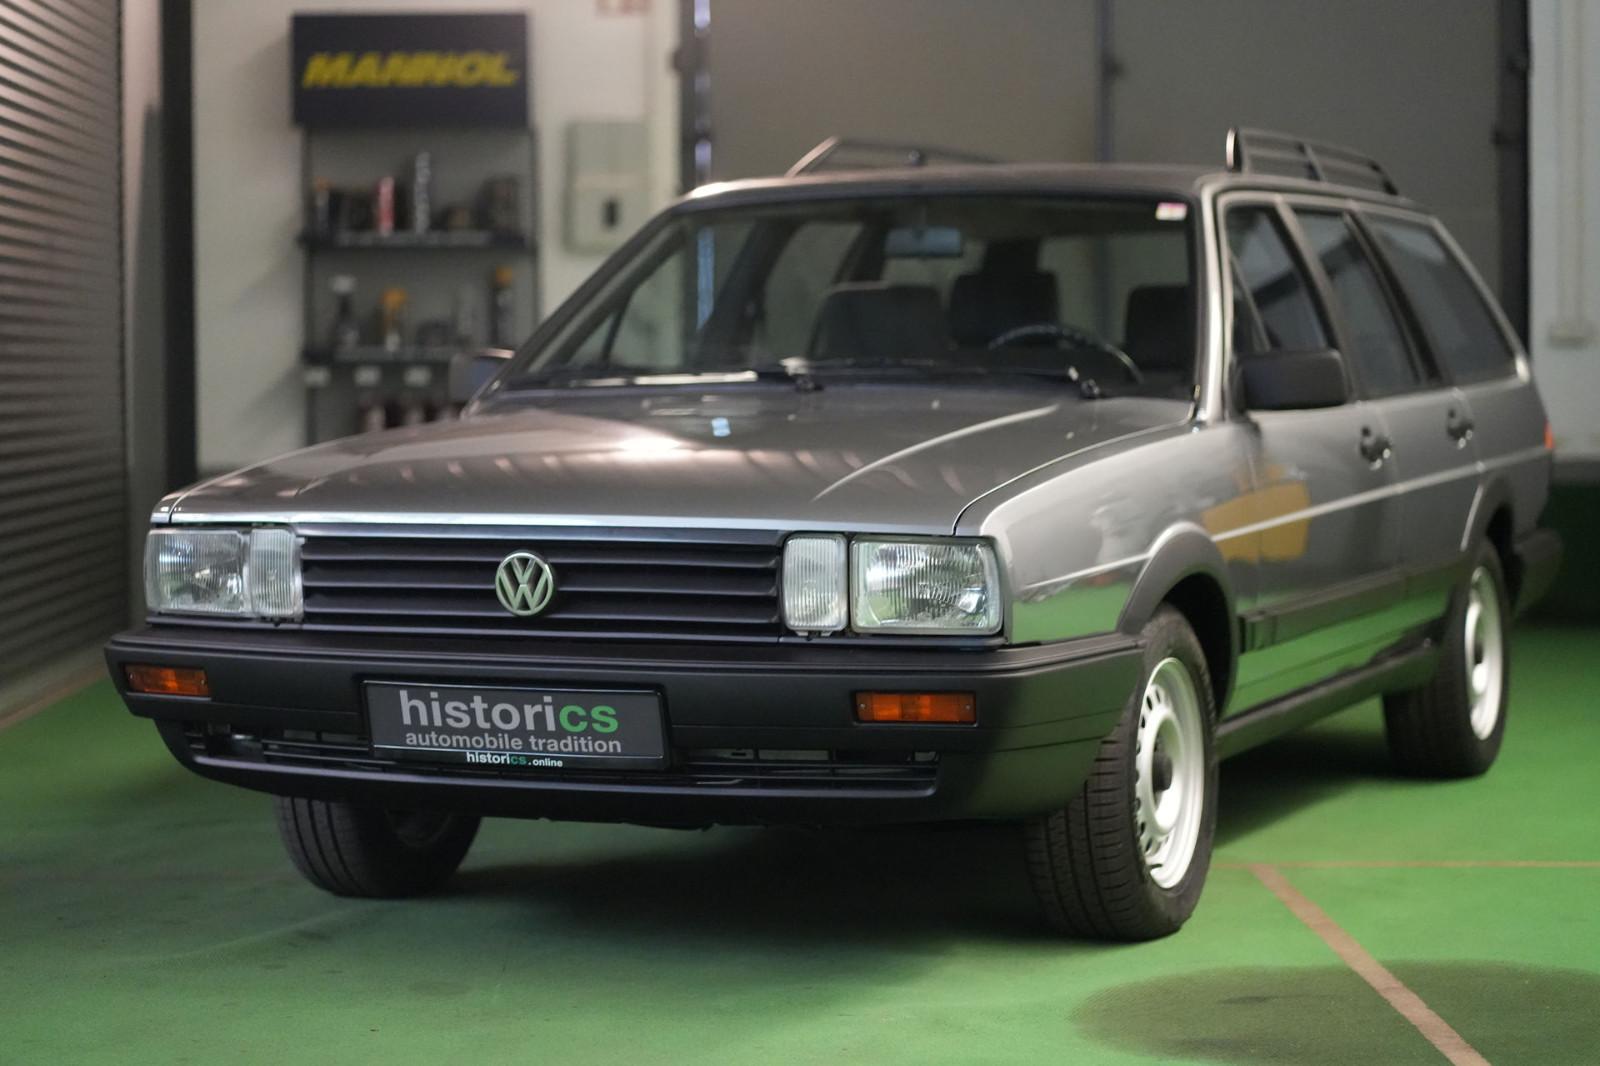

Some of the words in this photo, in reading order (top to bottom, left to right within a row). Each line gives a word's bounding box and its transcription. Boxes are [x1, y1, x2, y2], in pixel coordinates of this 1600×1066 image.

[303, 52, 518, 87] MANNOL
[400, 690, 619, 734] historics
[406, 731, 523, 751] automobile
[529, 734, 622, 754] tradition
